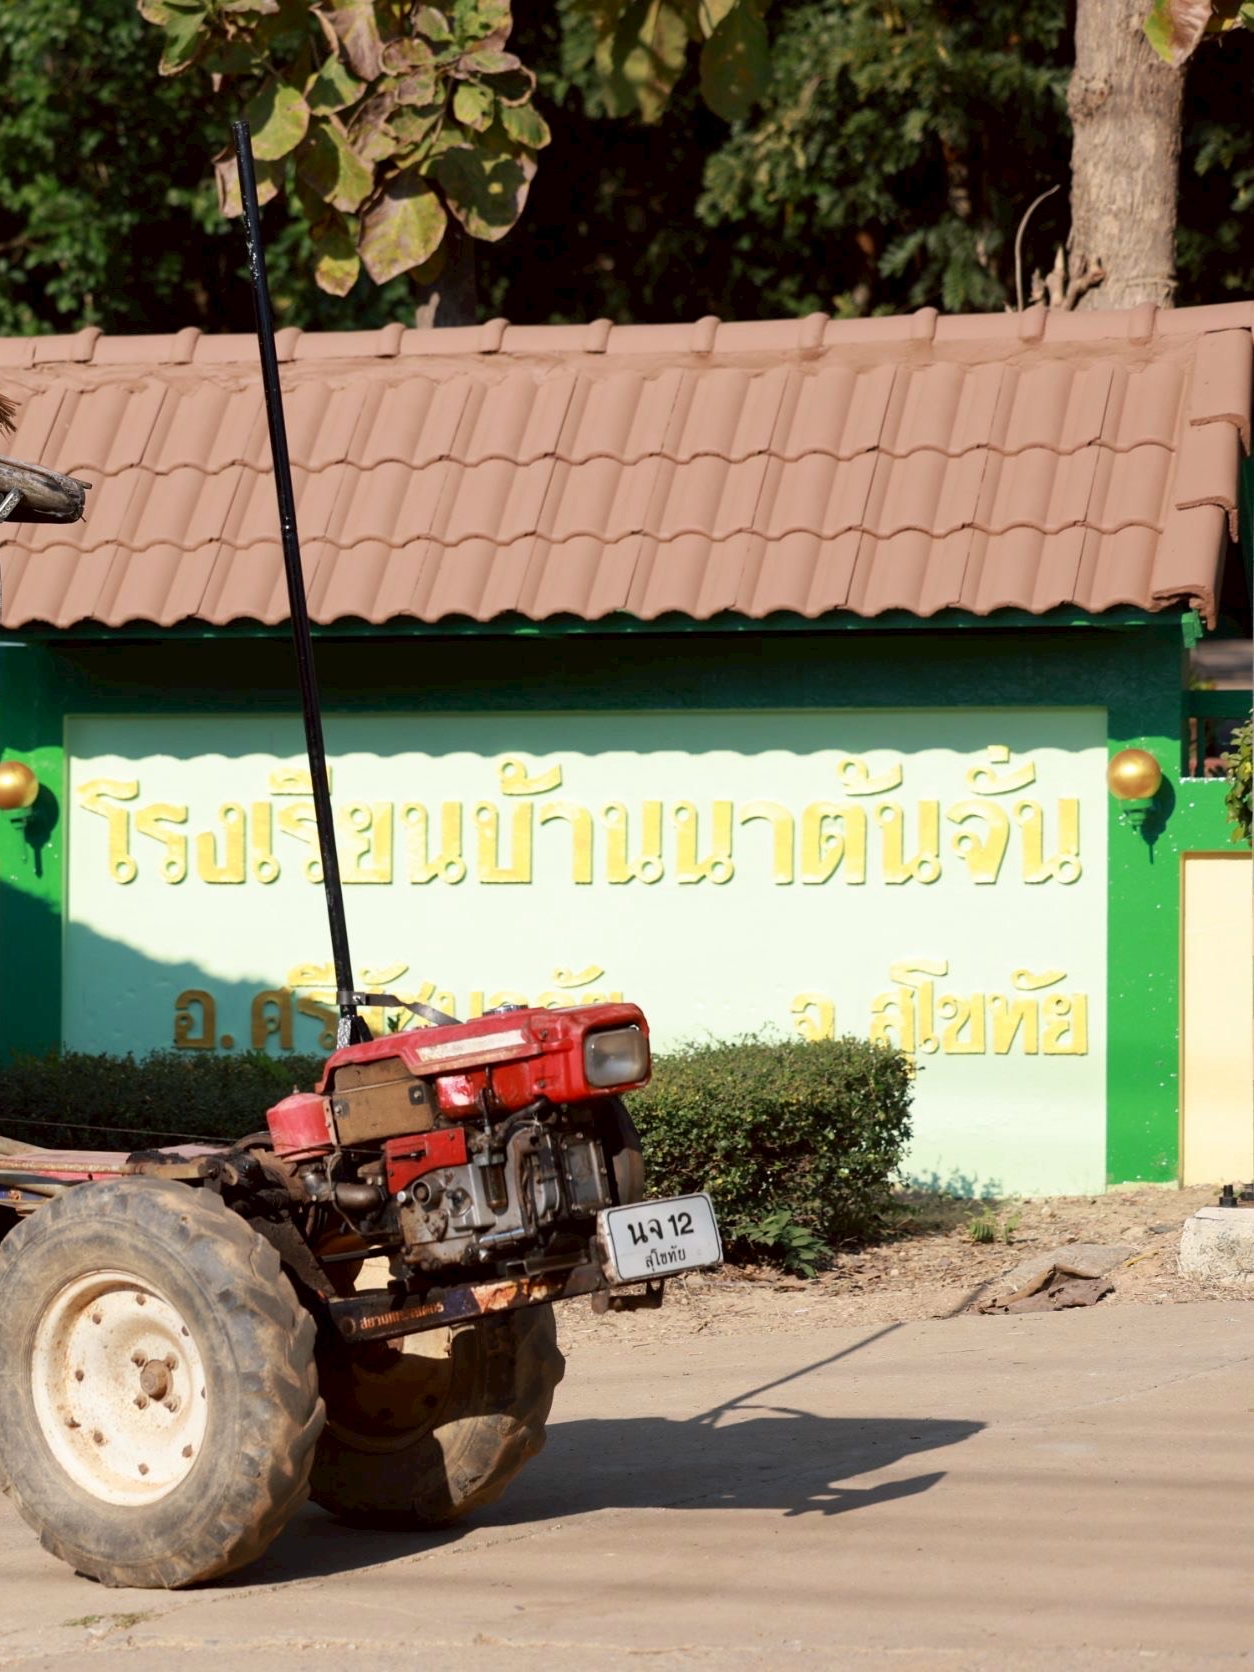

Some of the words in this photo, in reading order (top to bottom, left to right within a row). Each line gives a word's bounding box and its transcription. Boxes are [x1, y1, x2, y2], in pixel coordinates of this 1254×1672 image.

[627, 1219, 664, 1246] นจ
[667, 1212, 695, 1237] 12
[645, 1245, 688, 1272] สุโขทัย
